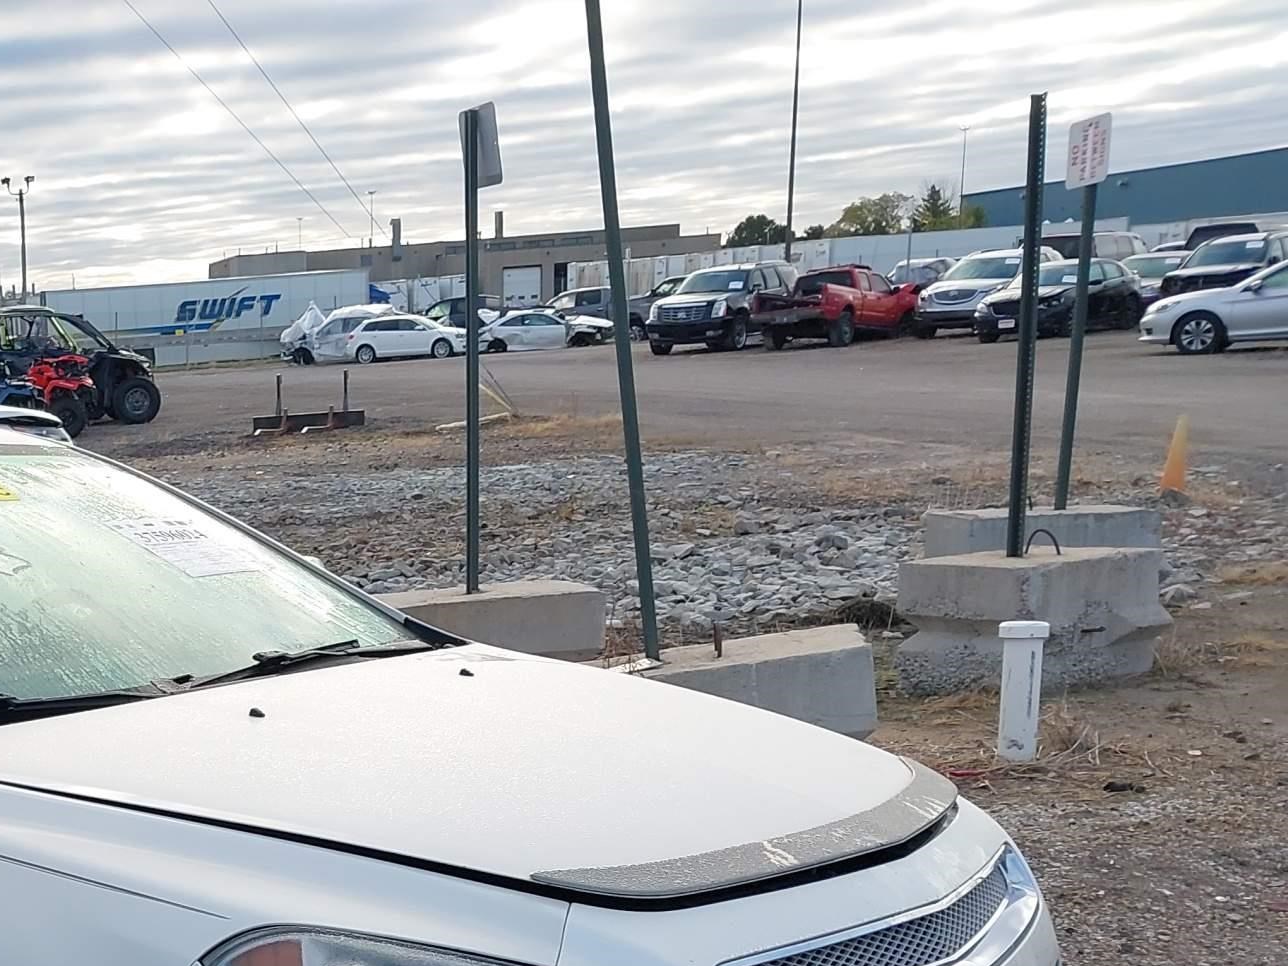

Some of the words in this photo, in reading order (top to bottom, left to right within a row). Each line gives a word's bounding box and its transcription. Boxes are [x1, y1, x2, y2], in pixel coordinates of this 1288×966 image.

[1071, 146, 1080, 166] NO
[175, 286, 282, 323] SWIFT
[133, 528, 209, 543] 37596024
